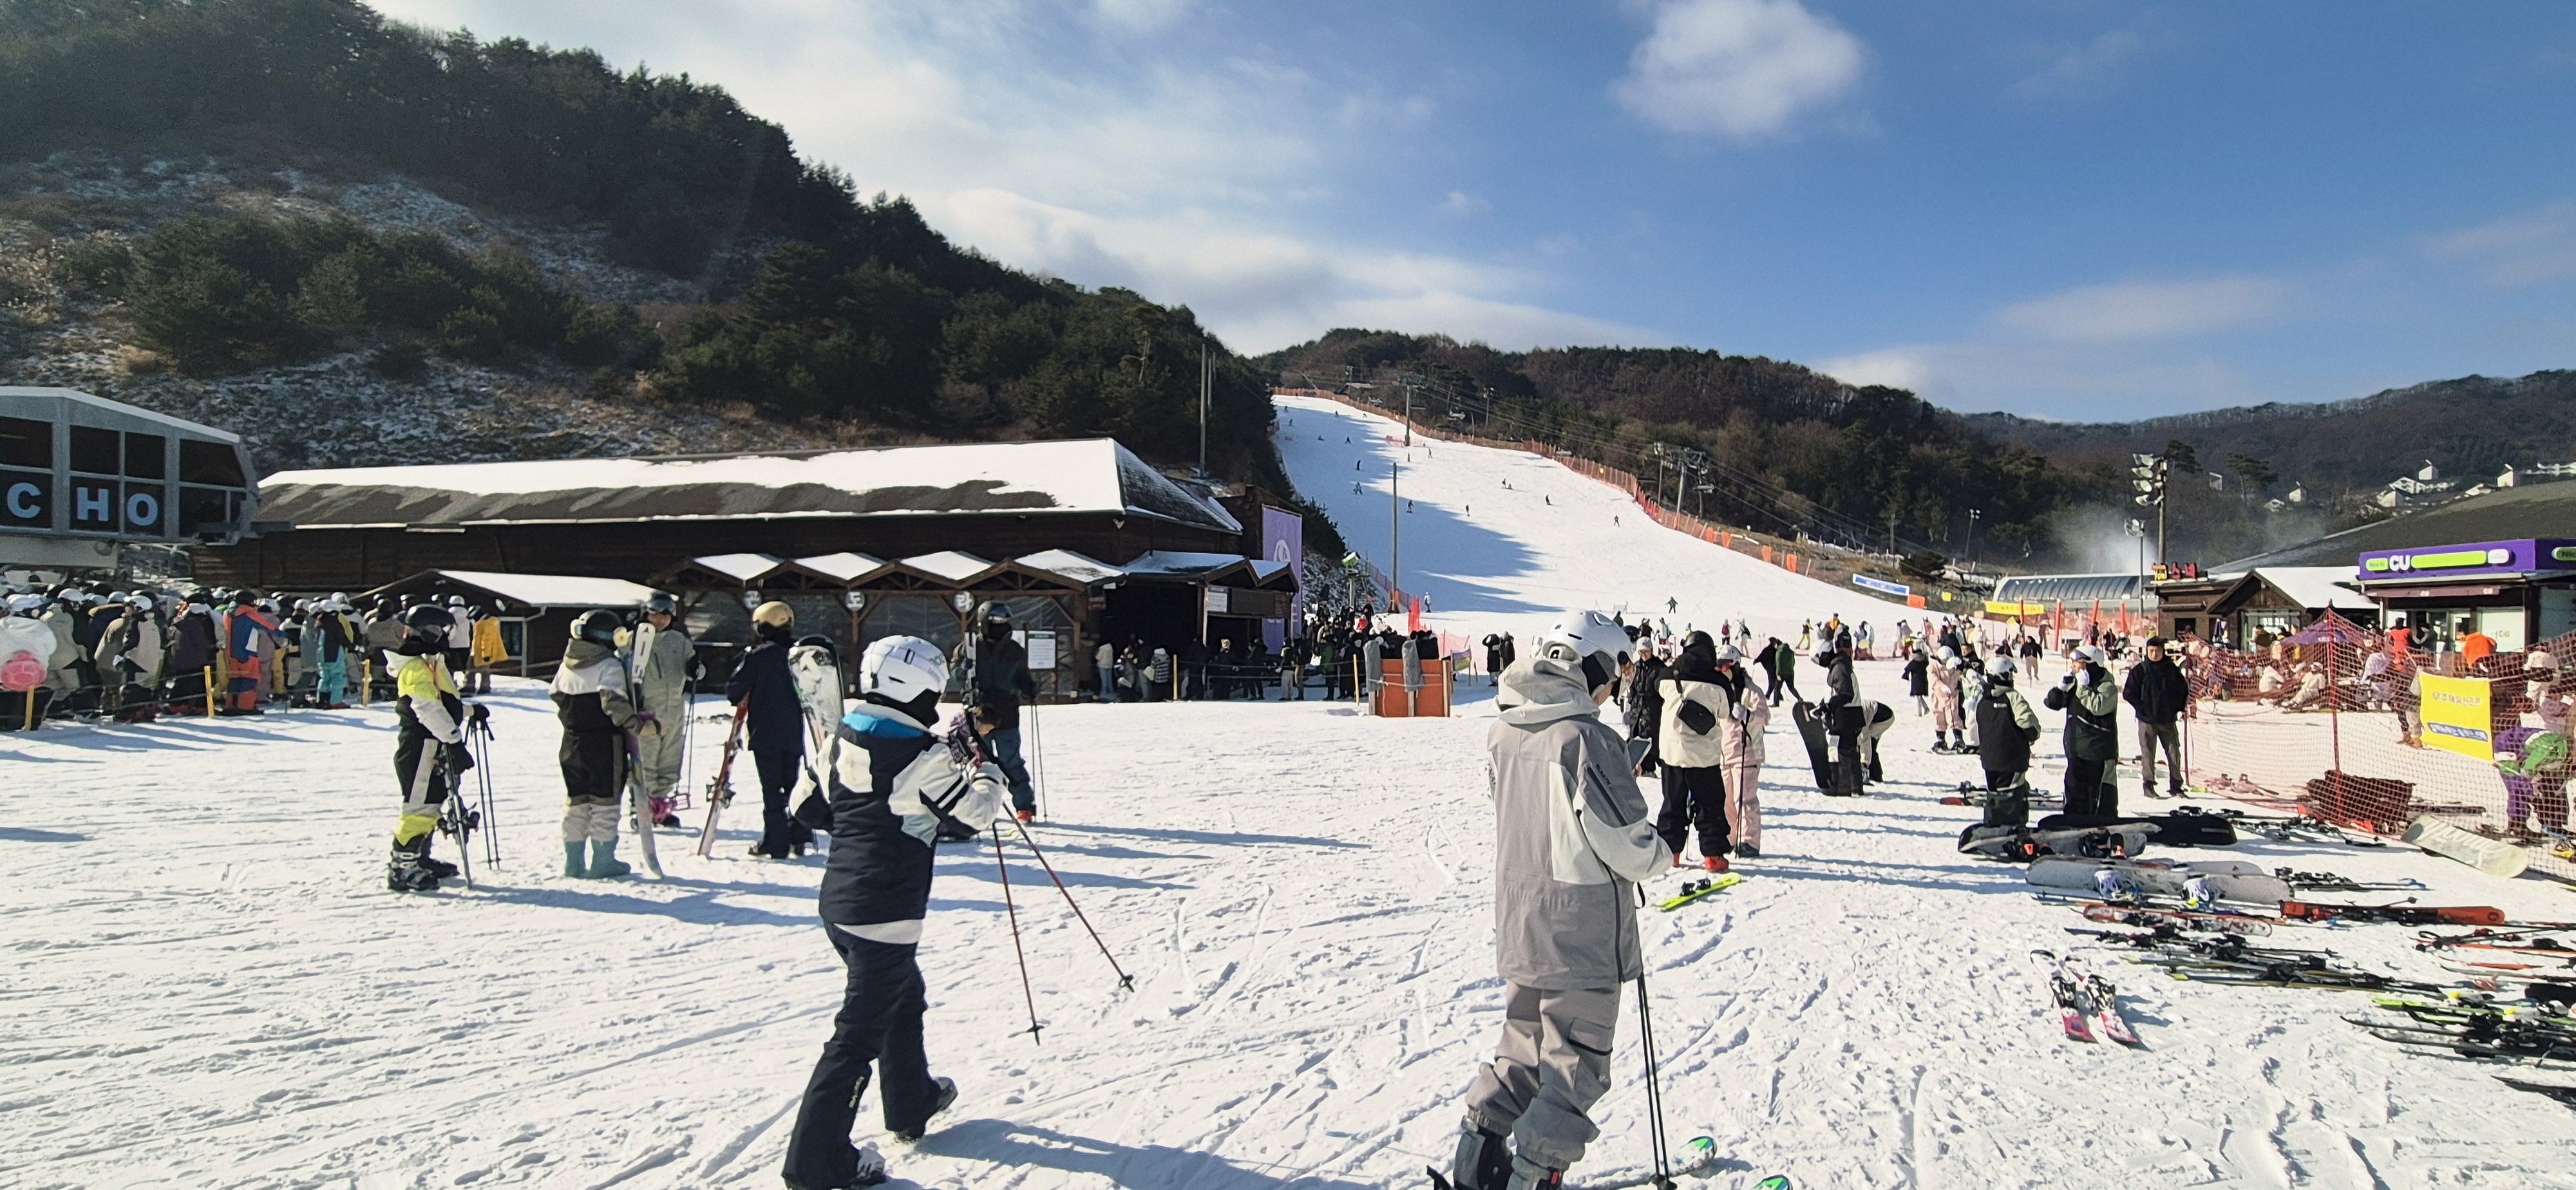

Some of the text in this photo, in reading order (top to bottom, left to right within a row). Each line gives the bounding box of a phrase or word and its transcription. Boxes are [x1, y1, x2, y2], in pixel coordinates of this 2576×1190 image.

[2389, 554, 2410, 571] CU
[846, 591, 864, 608] 도
[954, 590, 972, 609] 라
